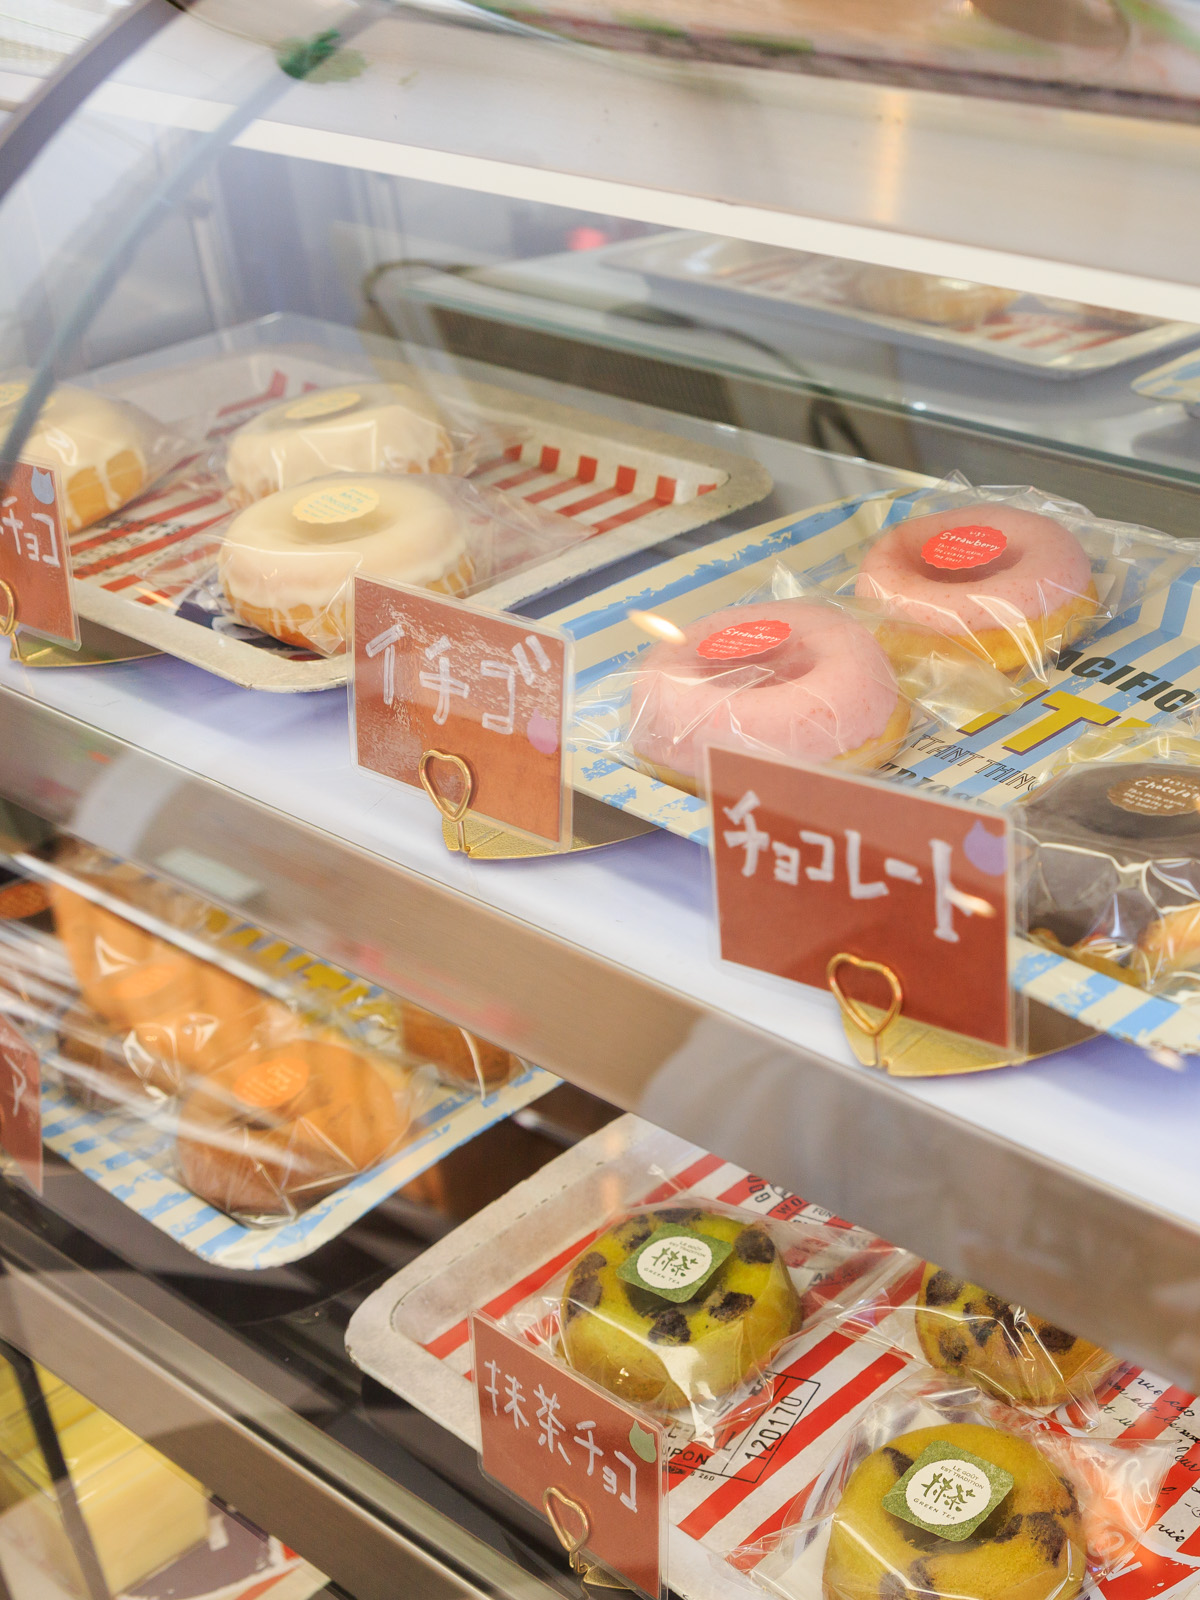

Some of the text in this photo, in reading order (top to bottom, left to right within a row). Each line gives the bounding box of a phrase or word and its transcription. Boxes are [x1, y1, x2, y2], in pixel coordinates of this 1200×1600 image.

[0, 496, 60, 568] チョコ
[940, 532, 1000, 552] Strawberry
[722, 627, 781, 644] Strawberry
[365, 624, 551, 734] イチゴ
[1054, 650, 1197, 713] ACIFIC
[722, 789, 997, 943] チョコレート
[484, 1359, 638, 1513] 抹茶チョコ
[745, 1396, 803, 1461] 120170
[940, 1465, 984, 1490] EST TRADITION
[961, 1469, 980, 1481] GOÛT
[913, 1497, 956, 1521] GREEN TEA
